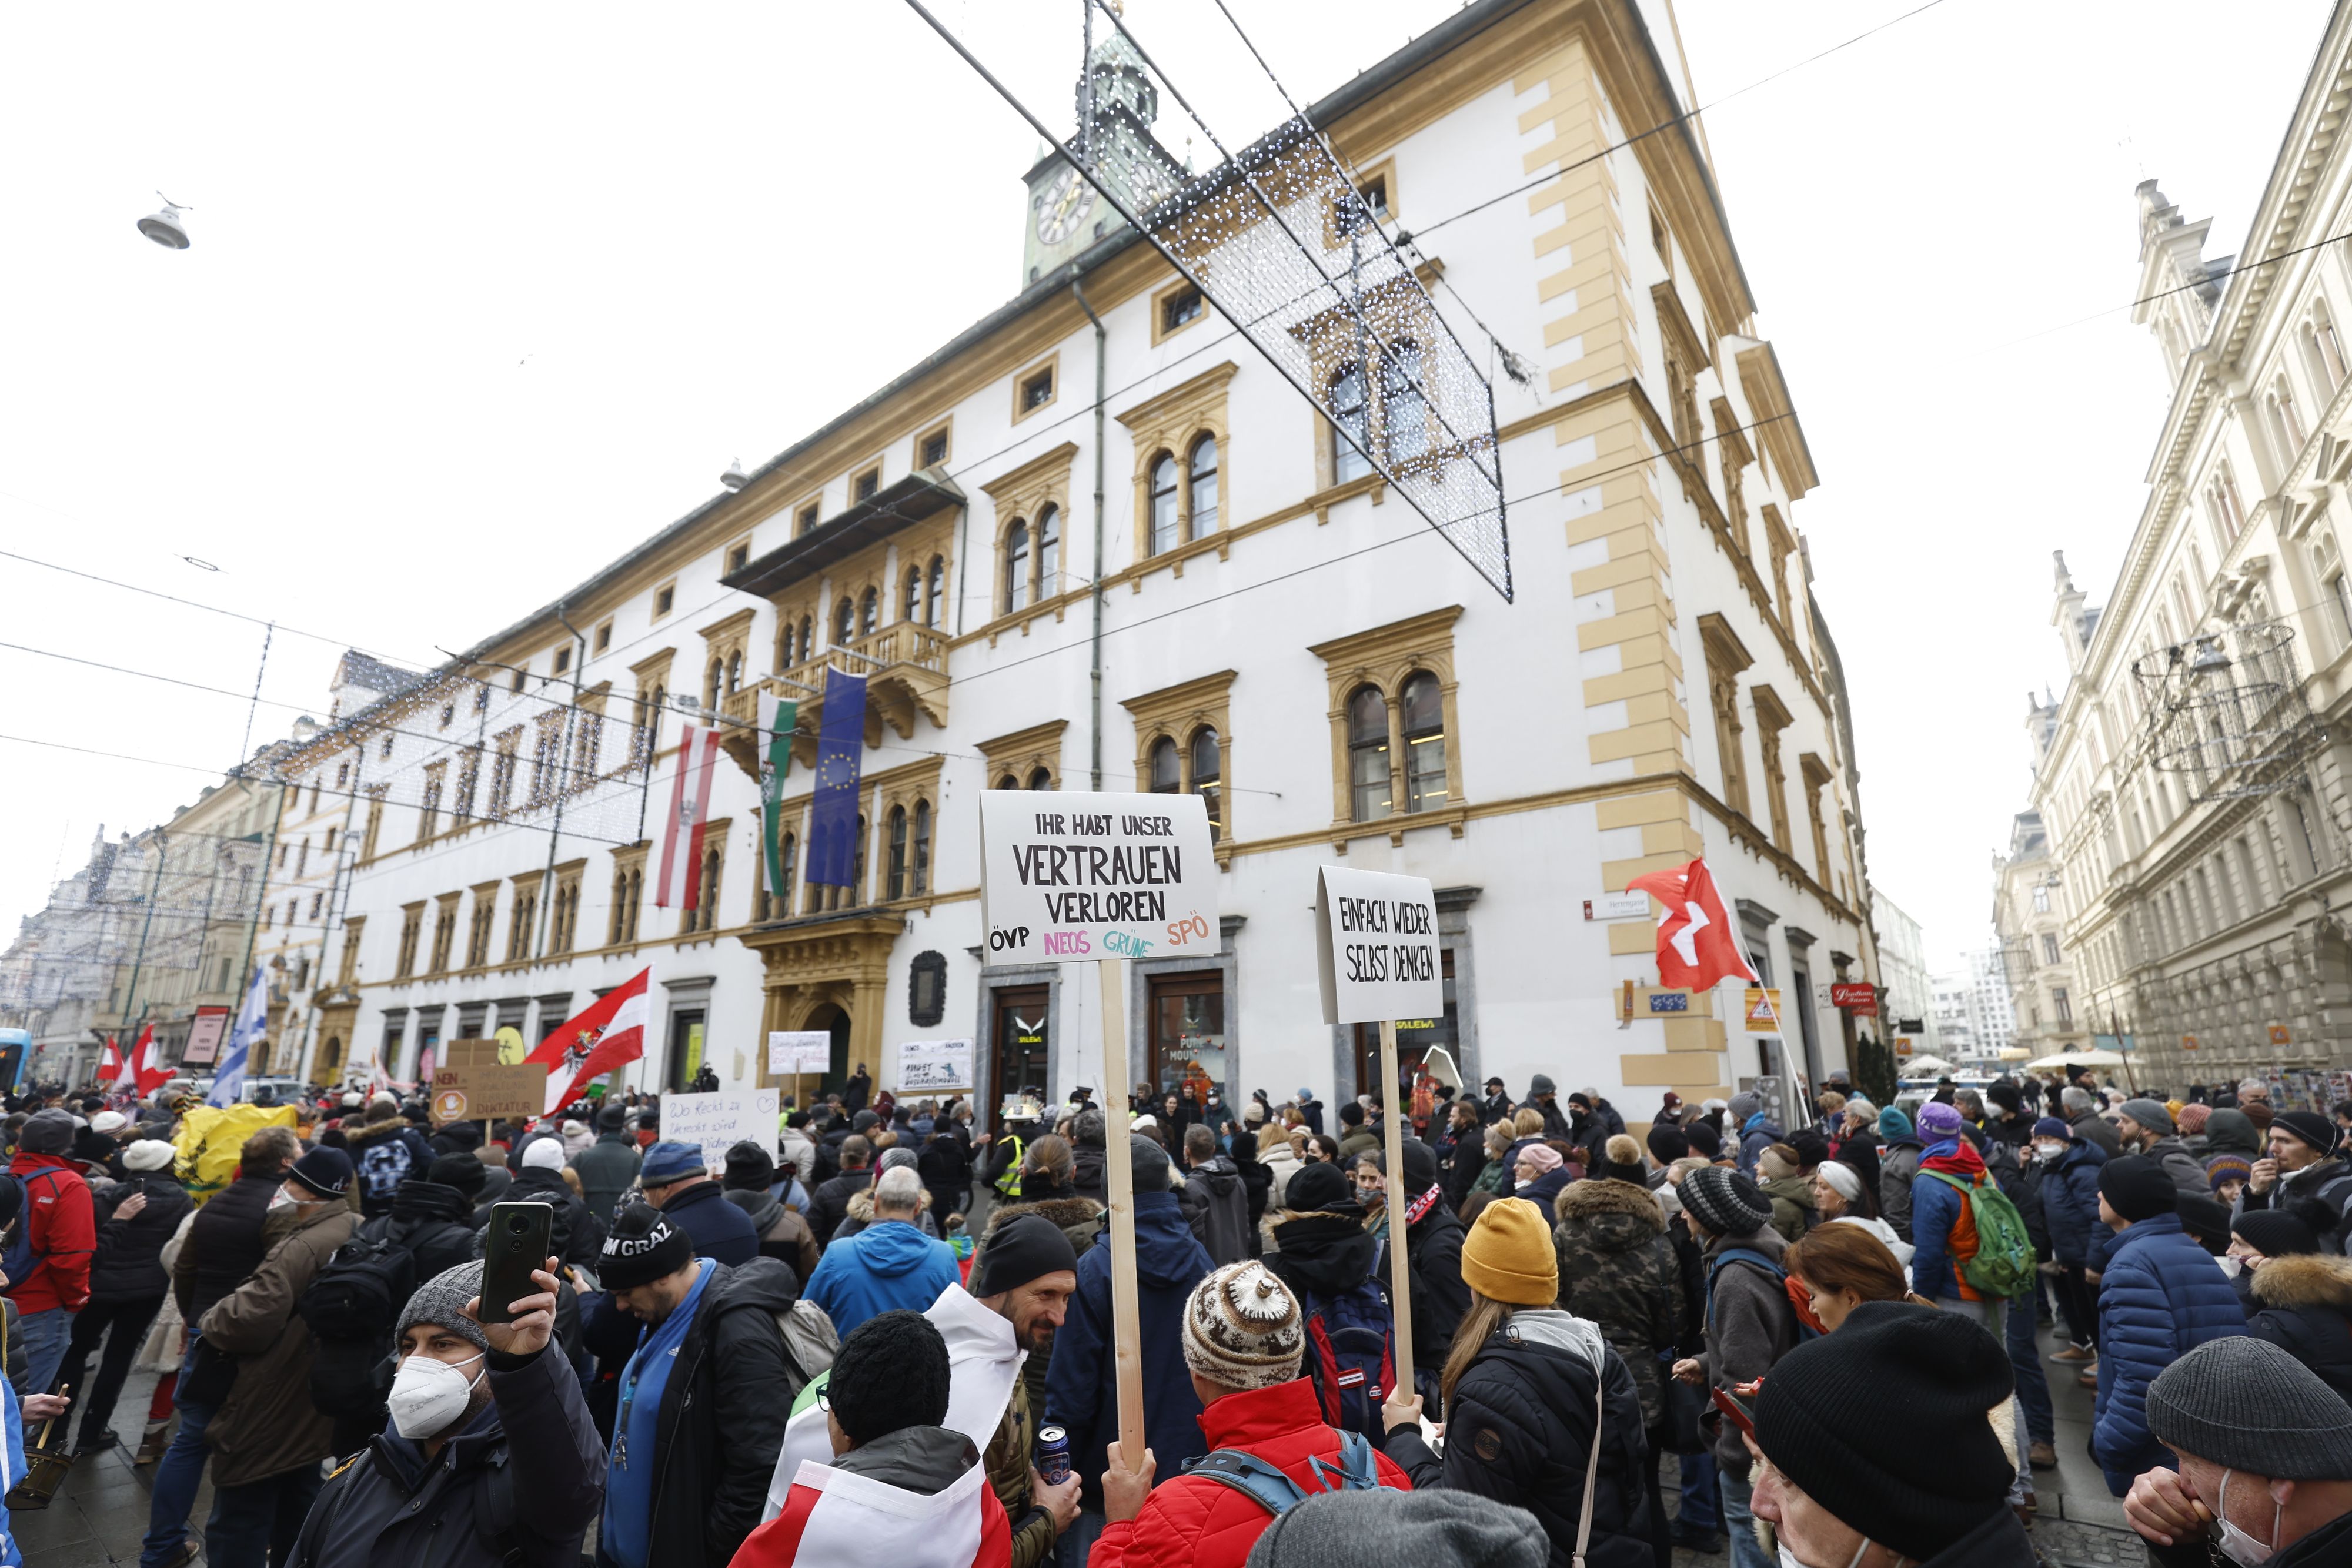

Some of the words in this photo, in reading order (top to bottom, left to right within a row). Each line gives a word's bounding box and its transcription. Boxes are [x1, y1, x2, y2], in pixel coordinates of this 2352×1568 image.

[1035, 813, 1066, 835] IHR
[1072, 814, 1113, 836] HABT
[1121, 815, 1174, 837] UNSER
[1012, 844, 1182, 886] VERTRAUEN
[1044, 891, 1166, 924] VERLOREN
[1339, 897, 1388, 933] EINFACH
[1392, 901, 1432, 935] WIEDER
[990, 925, 1030, 951] ÖVP
[1044, 930, 1091, 955] NEOS
[1103, 929, 1154, 958] GRÜNE
[1167, 910, 1209, 946] SPÖ
[1346, 944, 1388, 982] SELBST
[1394, 945, 1434, 982] DENKEN
[1396, 1019, 1435, 1029] SALEWA
[476, 1102, 531, 1115] DIKTATUR
[669, 1102, 690, 1118] Wo
[621, 1222, 673, 1256] GRAZ
